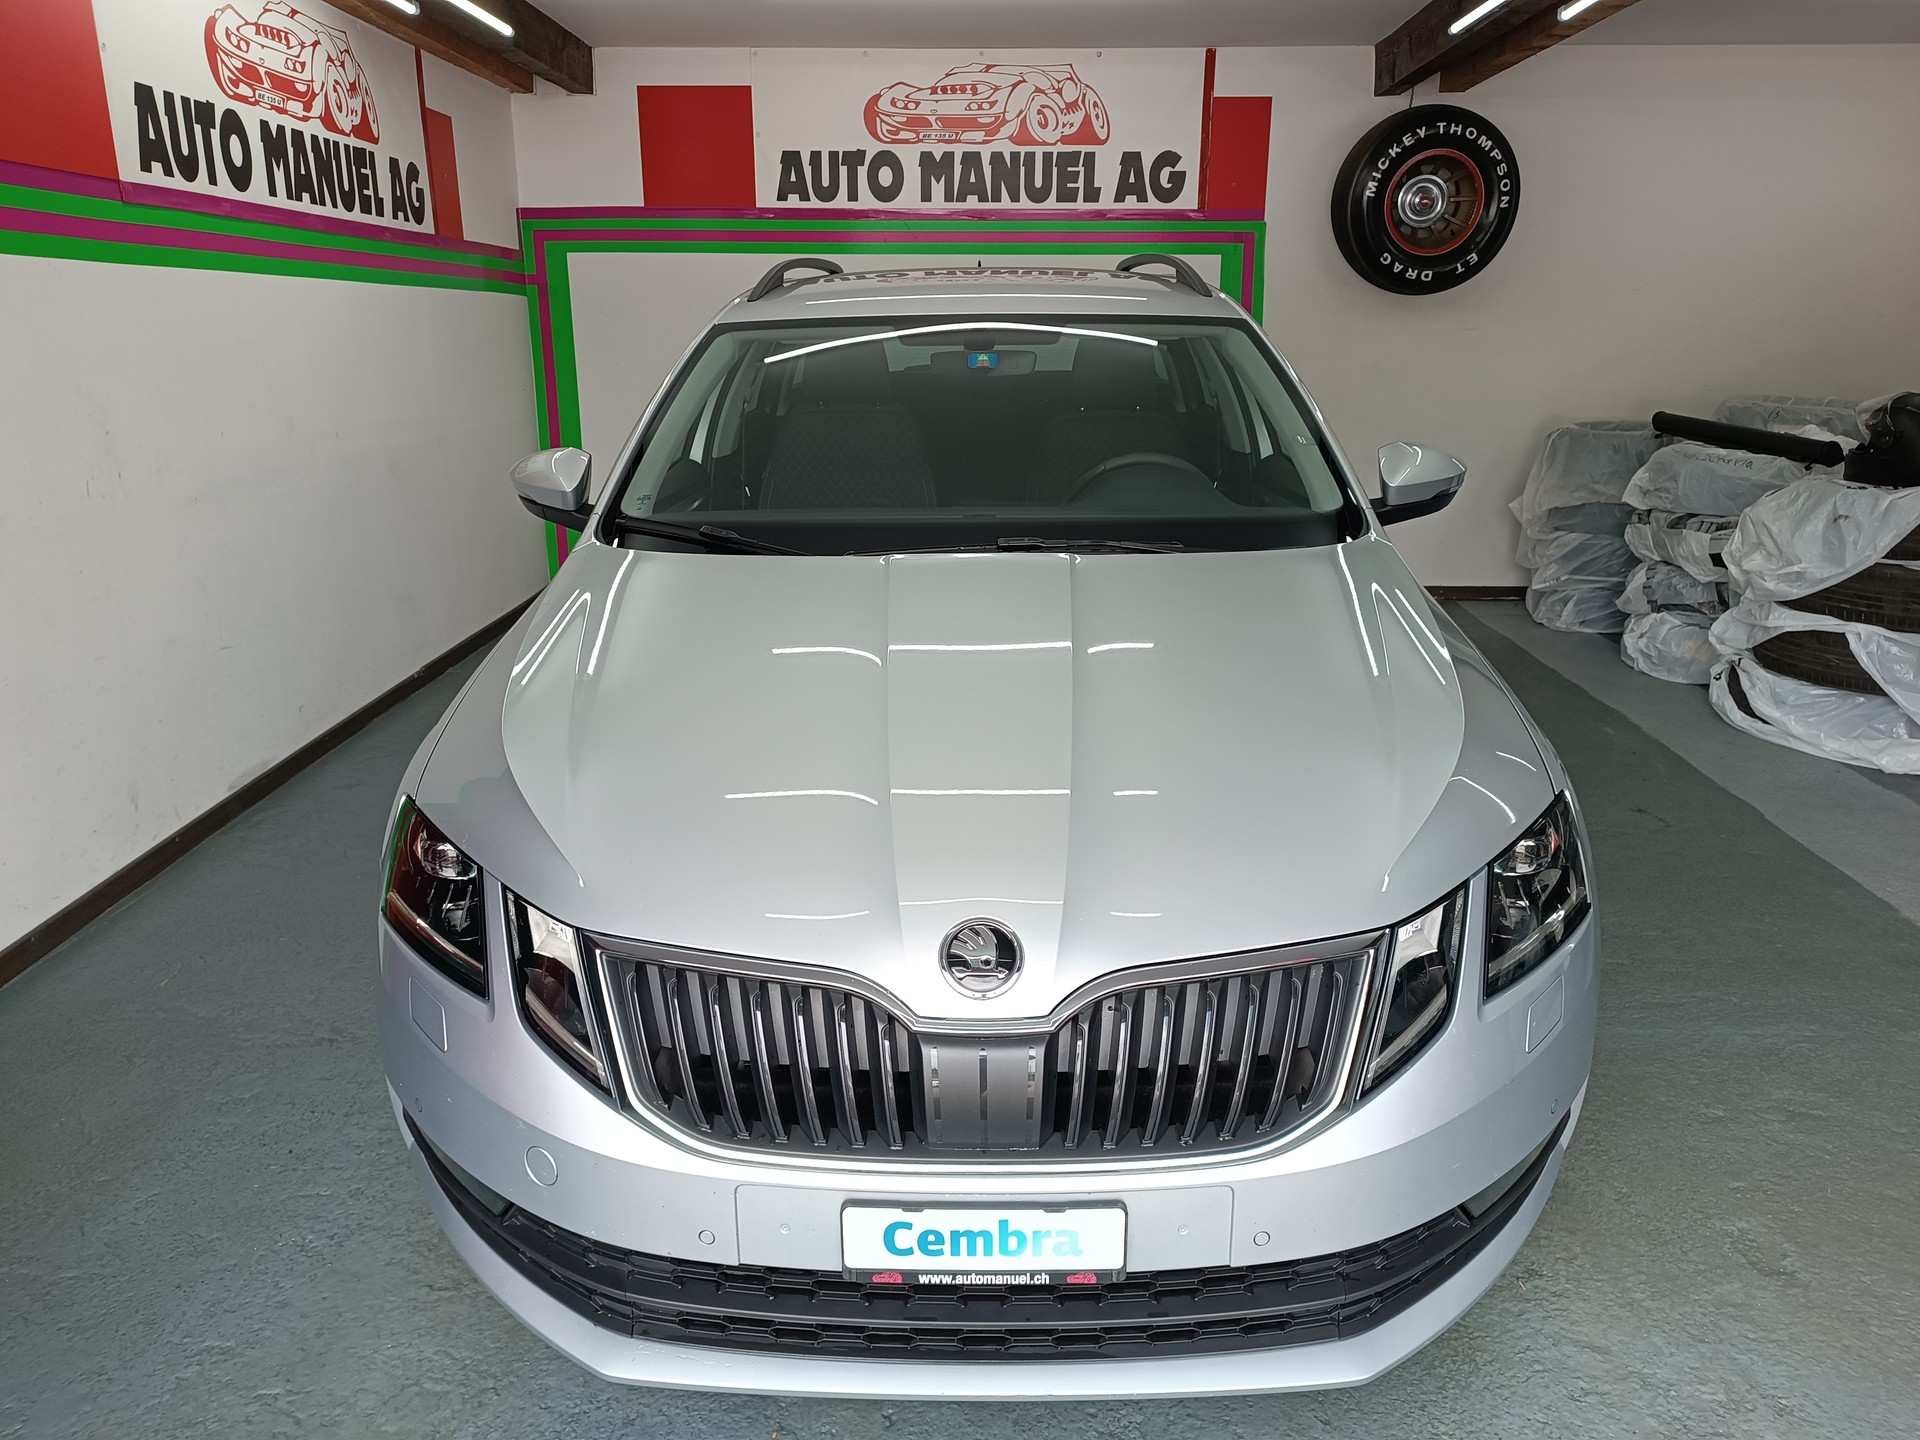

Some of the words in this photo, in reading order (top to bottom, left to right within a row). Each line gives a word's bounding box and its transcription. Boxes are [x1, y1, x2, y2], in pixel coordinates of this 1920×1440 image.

[257, 92, 266, 101] BE
[266, 94, 277, 104] 135
[277, 98, 282, 106] U
[134, 81, 252, 193] AUTO
[259, 118, 383, 218] MANUEL
[388, 156, 426, 227] AG
[1364, 125, 1427, 198] MICKEY
[1436, 121, 1511, 209] THOMPSON
[777, 148, 905, 203] AUTO
[918, 150, 1102, 204] MANUEL
[1113, 149, 1187, 204] AG
[1379, 251, 1434, 282] DRAG
[1455, 252, 1479, 275] ET
[882, 1219, 1084, 1259] Cembra
[918, 1272, 1050, 1286] www.automanuel.ch
